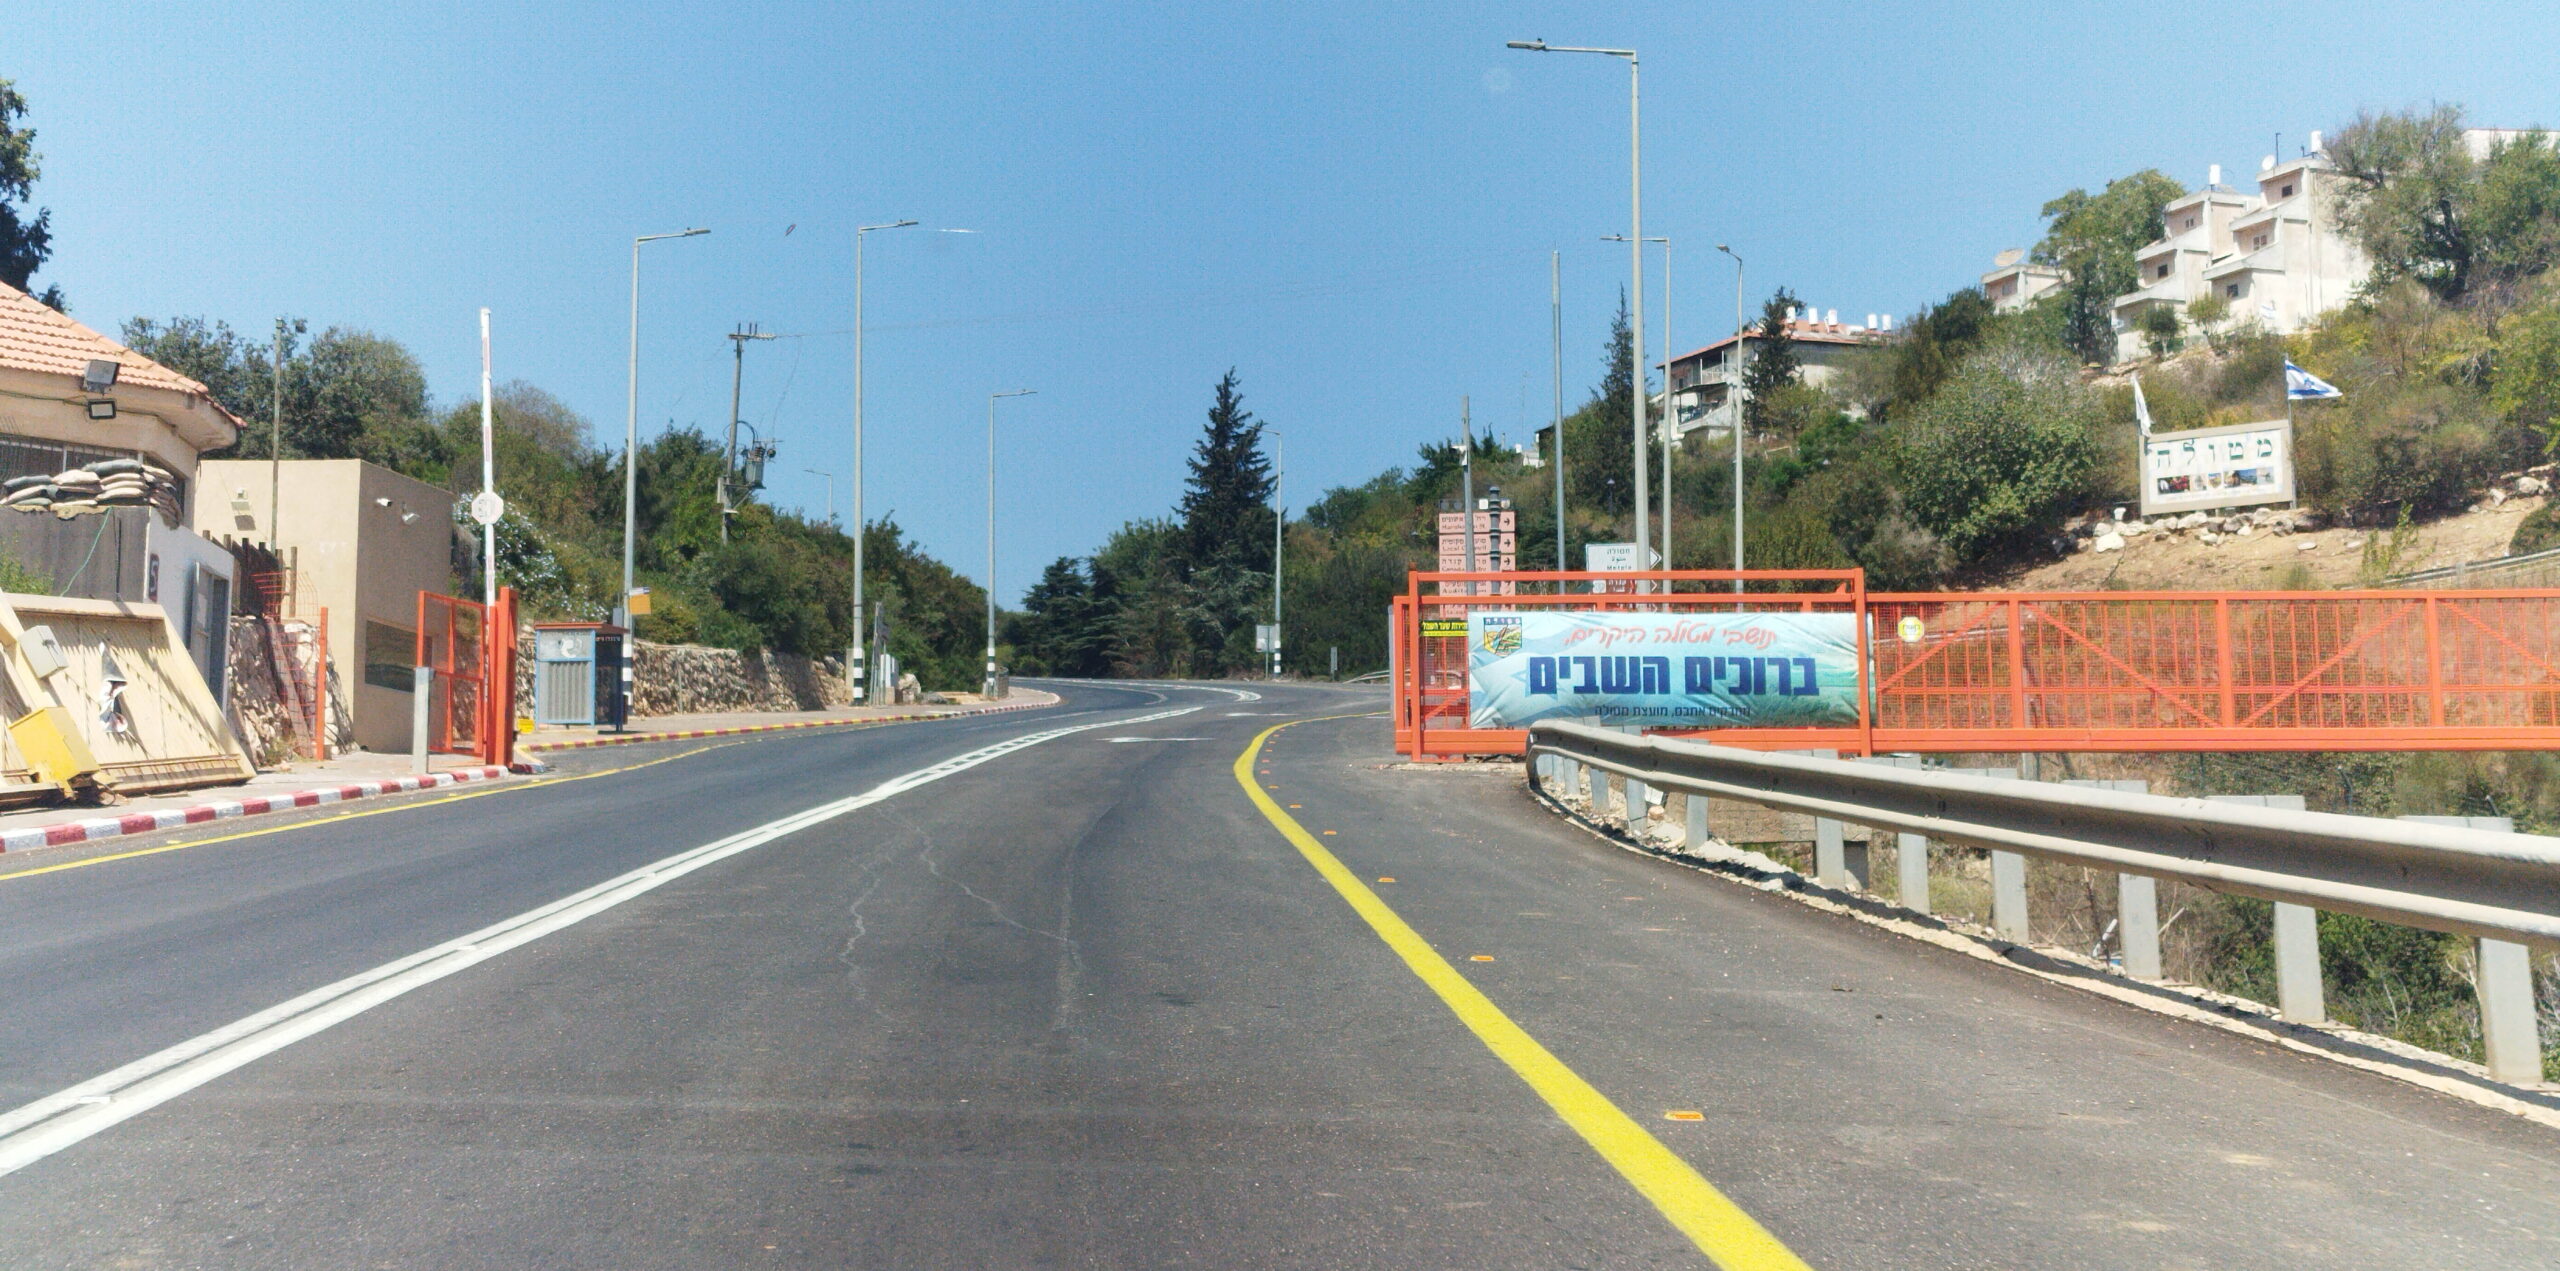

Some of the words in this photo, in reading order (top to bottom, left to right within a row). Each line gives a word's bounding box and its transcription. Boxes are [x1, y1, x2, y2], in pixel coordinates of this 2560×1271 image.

[2157, 438, 2273, 468] מטולה
[1563, 624, 1647, 649] היקרים,
[1653, 619, 1716, 644] מטולה
[1722, 625, 1778, 651] תושבי
[1529, 656, 1670, 695] השבים
[1685, 656, 1819, 695] ברוכים
[1594, 704, 1629, 717] מטולה
[1633, 705, 1668, 717] מועצת
